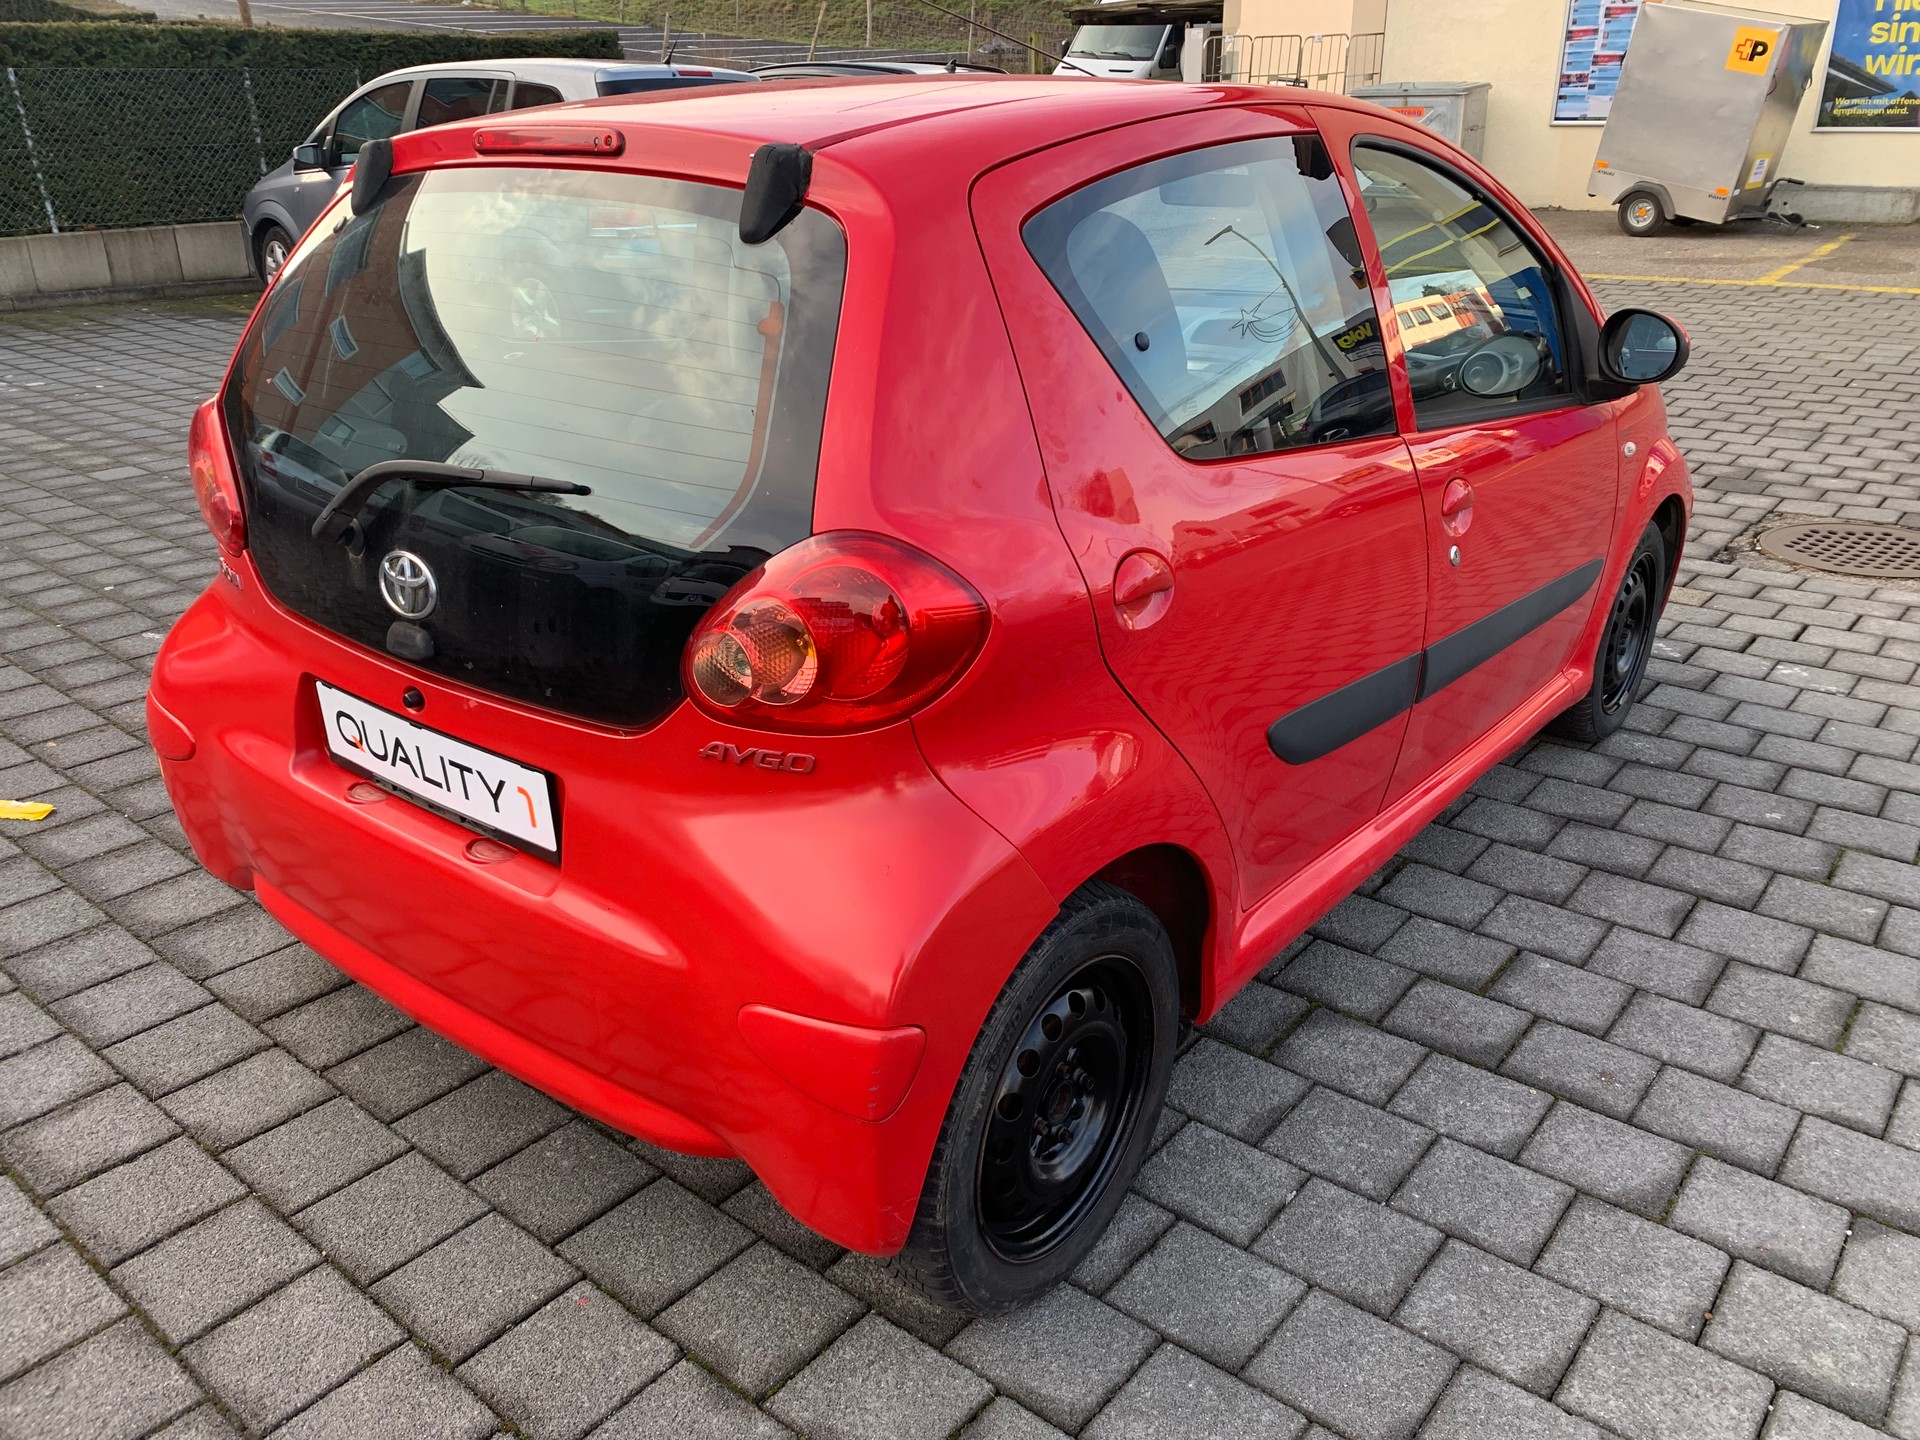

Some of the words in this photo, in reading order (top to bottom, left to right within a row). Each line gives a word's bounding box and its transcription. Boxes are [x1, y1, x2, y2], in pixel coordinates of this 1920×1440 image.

[1833, 107, 1885, 116] empfangen
[1886, 106, 1909, 115] wird.
[1835, 97, 1850, 105] Wo
[1873, 97, 1889, 105] mit
[335, 709, 506, 814] QUALITY
[697, 741, 816, 774] AYGO
